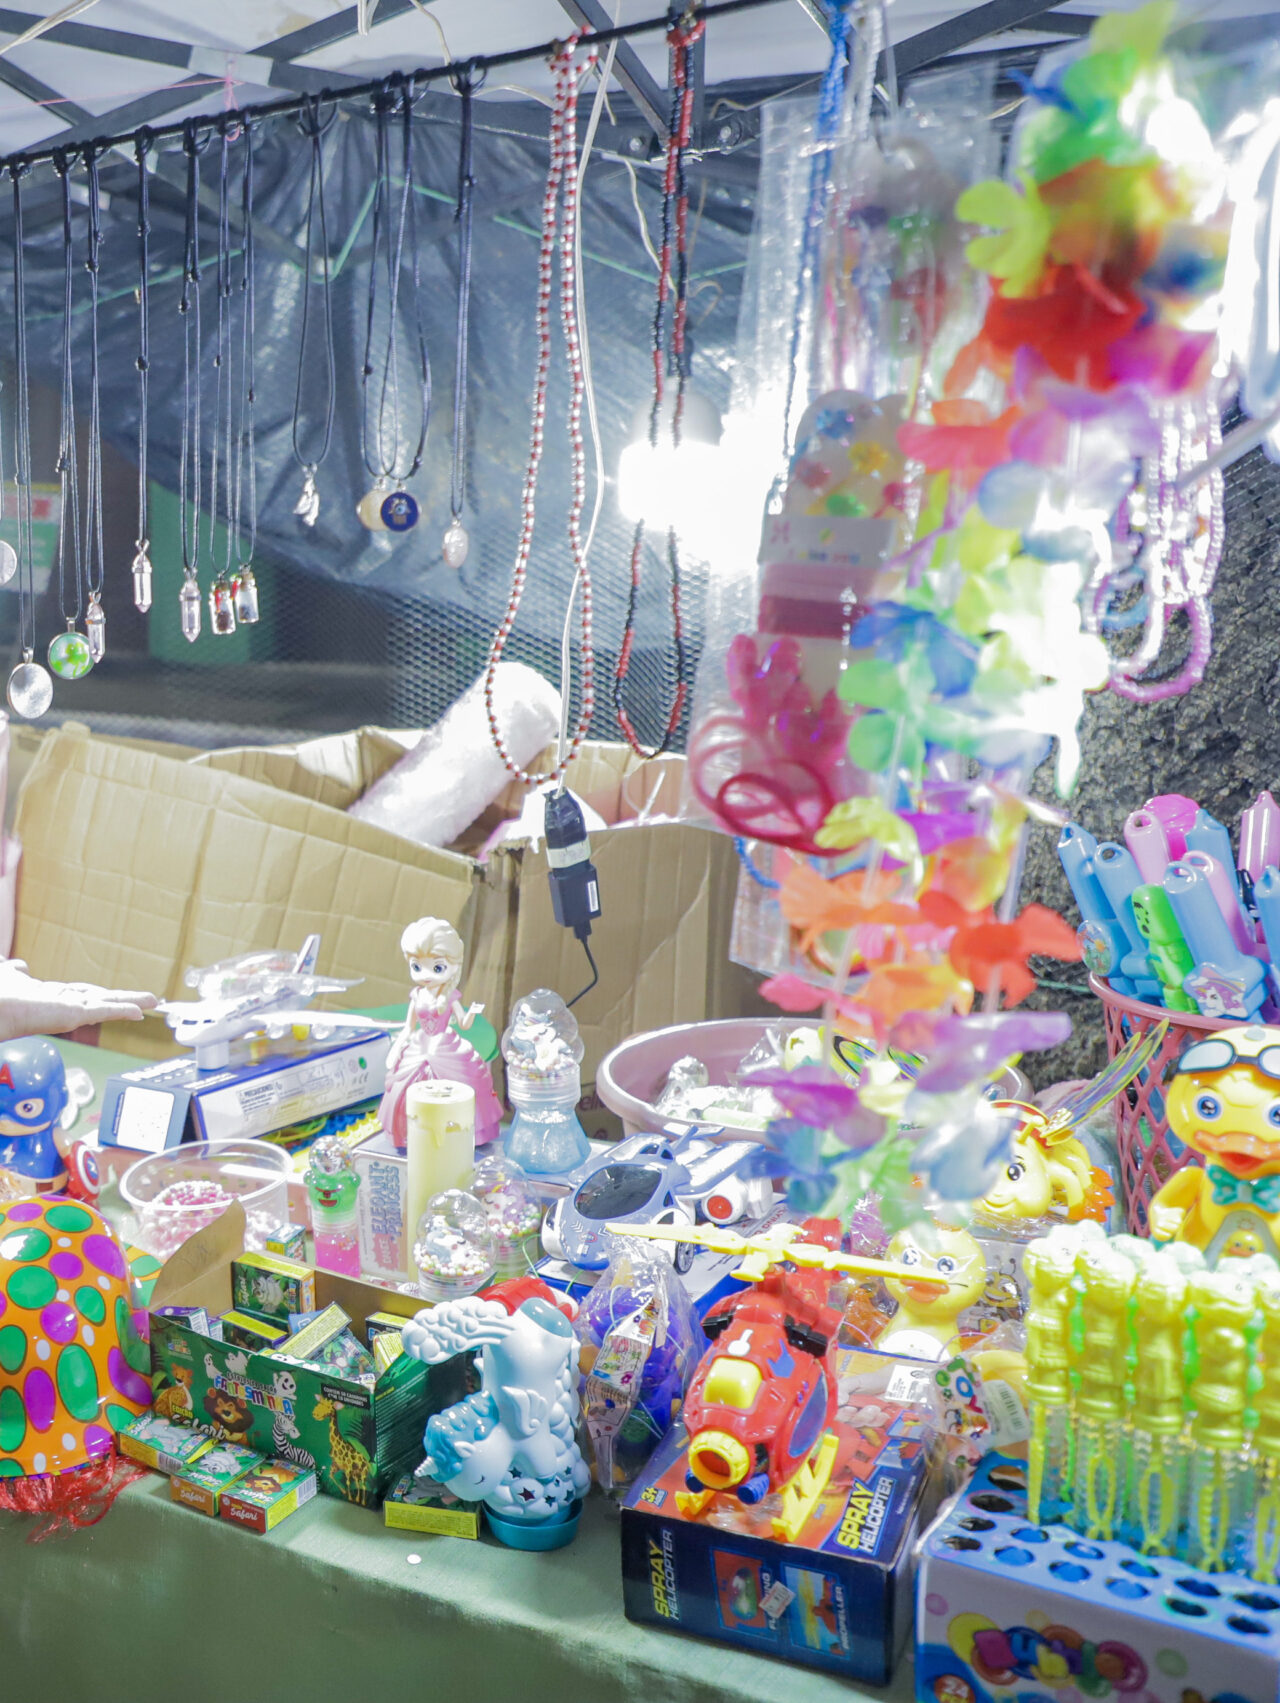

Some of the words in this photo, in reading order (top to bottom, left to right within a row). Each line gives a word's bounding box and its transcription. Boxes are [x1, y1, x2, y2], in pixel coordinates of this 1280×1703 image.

[213, 1375, 295, 1416] FANTASMINHA
[230, 1507, 258, 1521] Safari
[641, 1486, 658, 1503] 3+
[837, 1483, 875, 1549] SPRAY
[859, 1477, 894, 1553] HELICOPTER
[649, 1539, 670, 1618] SPRAY
[662, 1529, 680, 1621] HELICOPTER
[761, 1572, 776, 1631] FLING
[835, 1586, 850, 1651] PROPELLER
